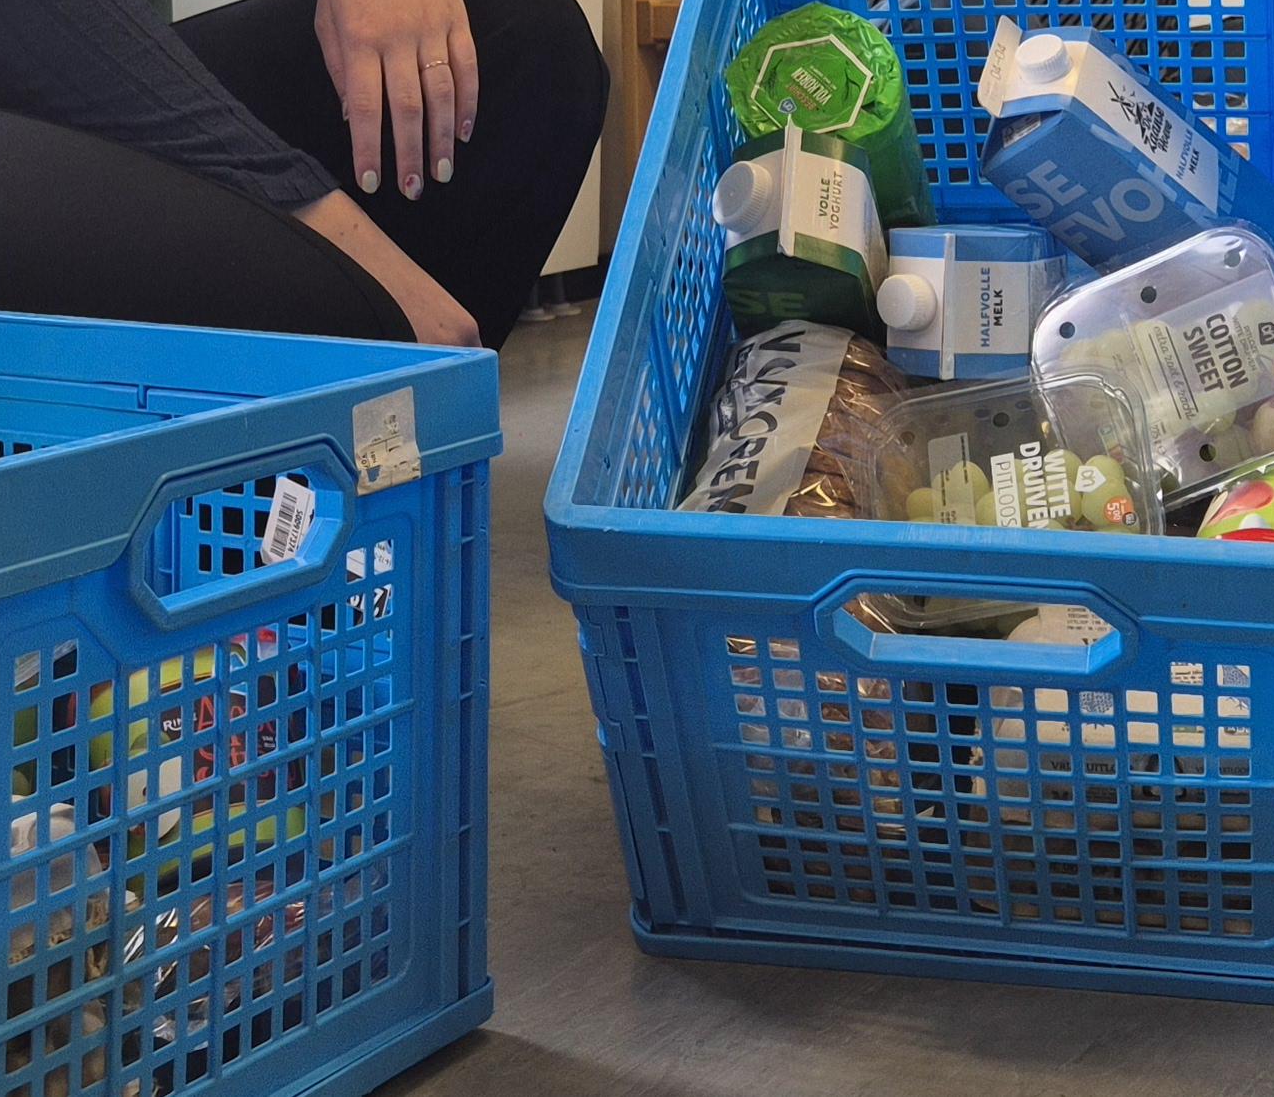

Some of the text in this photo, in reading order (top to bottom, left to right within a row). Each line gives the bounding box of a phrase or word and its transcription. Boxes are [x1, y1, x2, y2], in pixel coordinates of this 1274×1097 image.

[1176, 129, 1194, 180] HALFVOLLE
[1189, 149, 1201, 175] MELK
[818, 177, 831, 218] VOLLE
[828, 170, 844, 231] YOGHURT
[980, 267, 991, 348] HALFVOLLE
[993, 289, 1003, 327] MELK
[1182, 326, 1224, 392] SWEET
[1205, 313, 1249, 390] COTTON
[995, 460, 1018, 527] PITLOOS
[1043, 449, 1072, 519] WITTE
